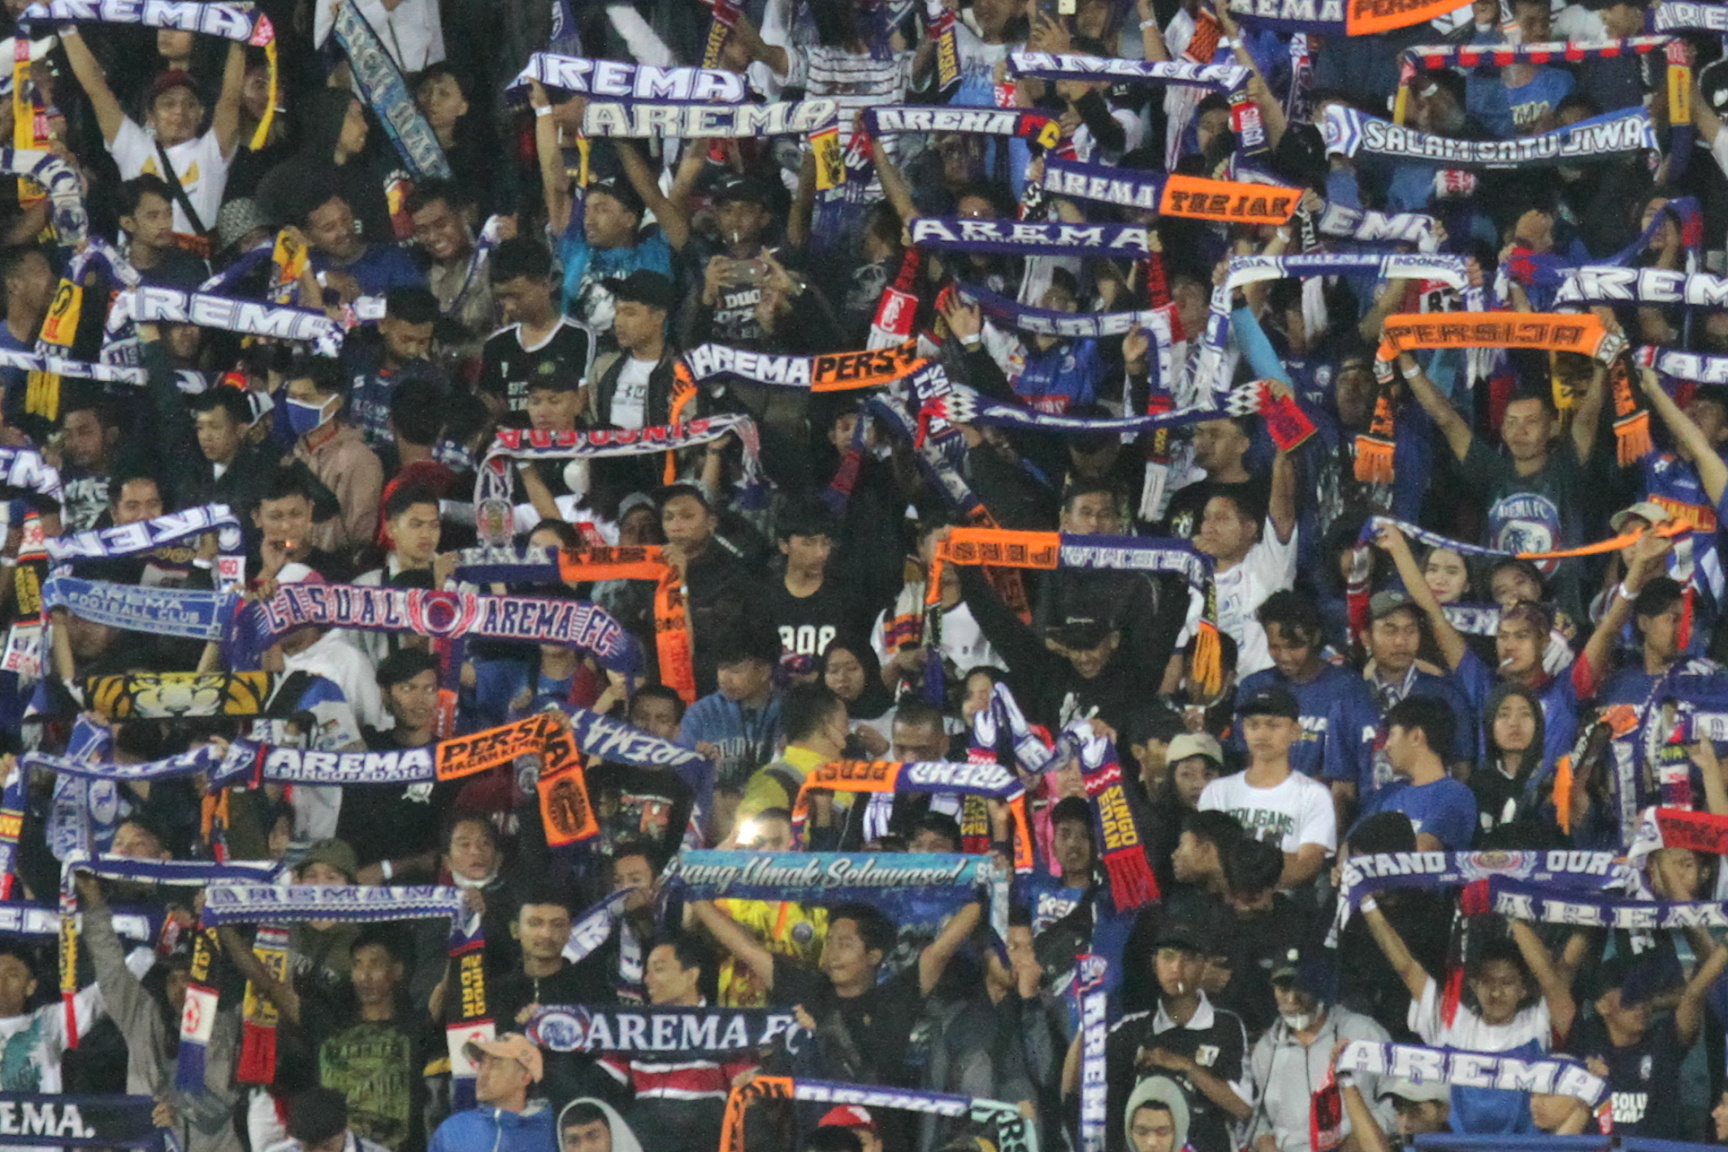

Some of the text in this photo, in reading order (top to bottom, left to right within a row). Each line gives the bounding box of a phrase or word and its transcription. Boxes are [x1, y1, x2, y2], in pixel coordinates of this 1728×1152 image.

[584, 99, 839, 139] AREMA
[878, 106, 1019, 135] AREMA
[1364, 117, 1645, 162] SALAM SATU JIWA
[1044, 167, 1155, 209] AREMA
[914, 218, 1151, 252] AREMA
[693, 345, 811, 387] AREMA
[459, 545, 552, 566] EMA
[266, 584, 404, 637] CASUAL
[482, 598, 573, 641] AREMA
[268, 747, 433, 774] AREMA
[1097, 793, 1122, 851] EDAN
[1108, 784, 1140, 849] SINGO
[752, 856, 822, 889] Umak
[1341, 850, 1612, 892] STAND OUR
[211, 883, 460, 905] AREMANI
[585, 1012, 750, 1053] AREMA
[1336, 1039, 1606, 1105] AREMA
[1610, 1091, 1648, 1110] SOLU
[0, 1103, 97, 1139] EMA.
